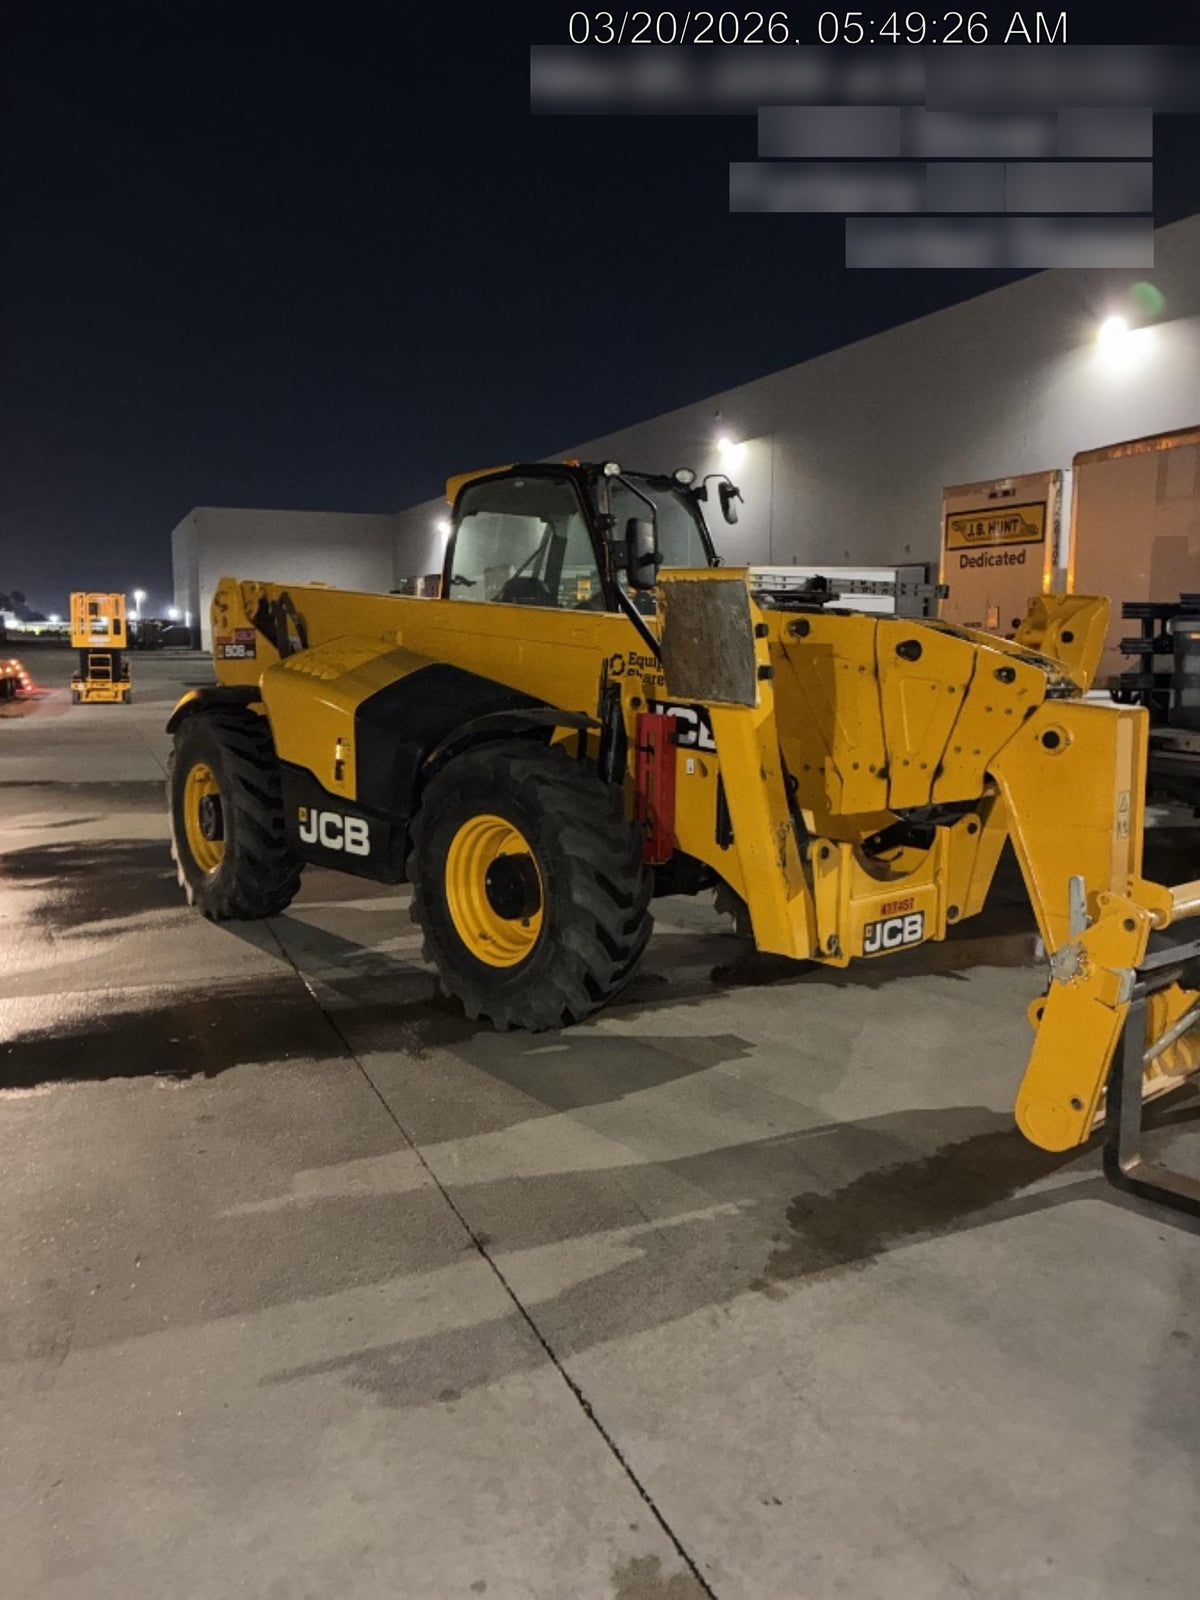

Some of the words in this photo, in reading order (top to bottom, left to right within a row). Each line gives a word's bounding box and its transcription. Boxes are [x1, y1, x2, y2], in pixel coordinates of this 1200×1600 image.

[988, 518, 1019, 535] HUNT
[959, 549, 1026, 569] Dedicated
[299, 808, 370, 856] JCB
[864, 913, 922, 952] JCB
